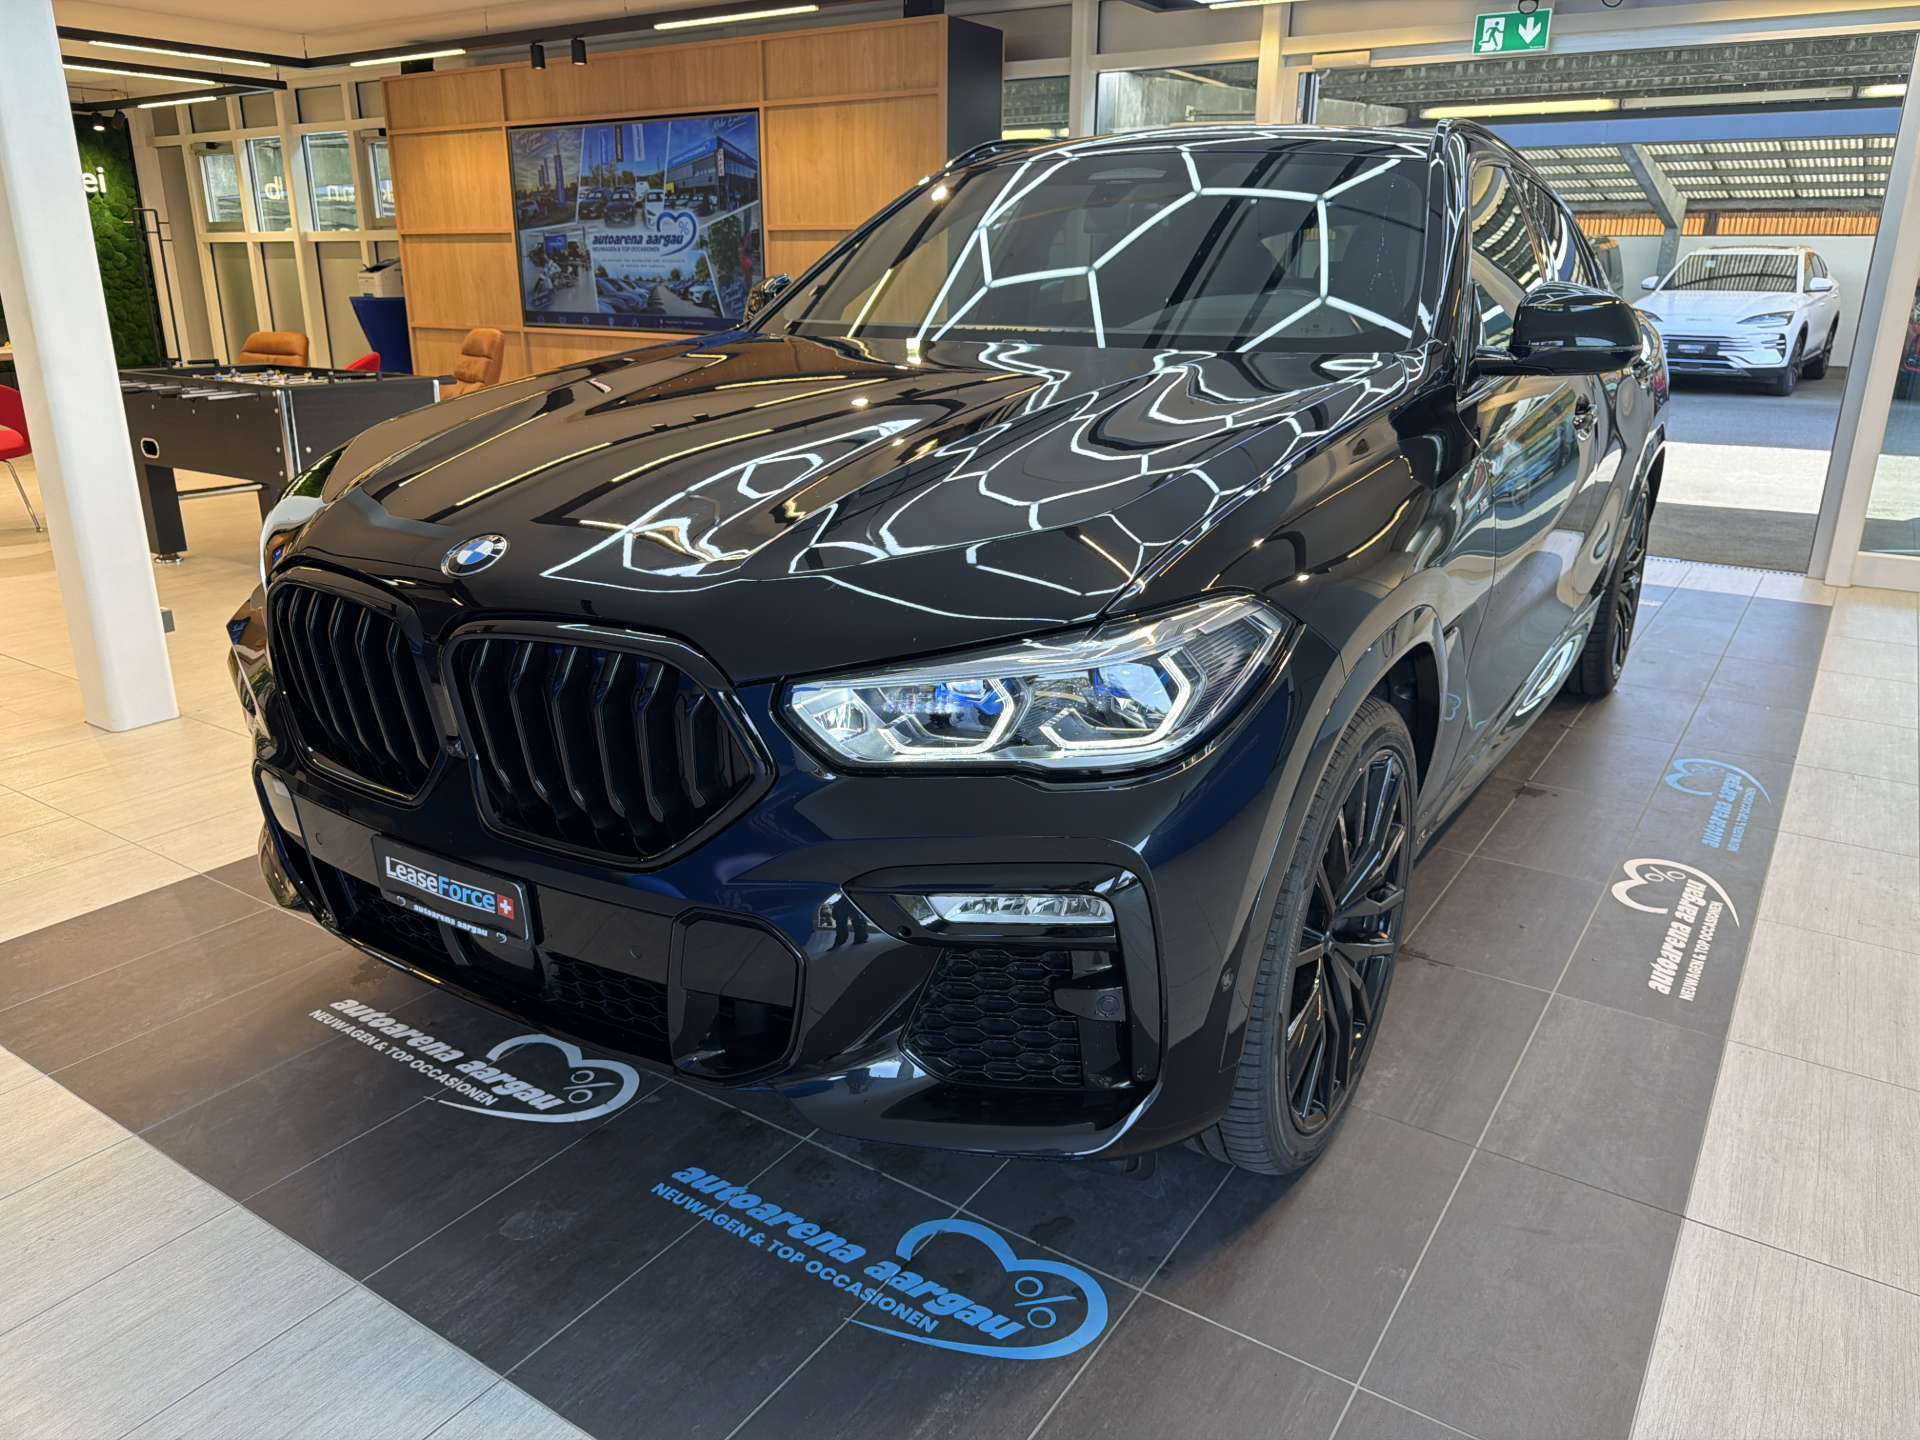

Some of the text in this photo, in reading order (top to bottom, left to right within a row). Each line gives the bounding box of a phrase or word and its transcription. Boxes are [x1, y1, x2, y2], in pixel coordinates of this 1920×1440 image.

[82, 166, 107, 193] ei
[592, 234, 684, 247] autoarena aargau
[385, 856, 496, 910] LeaseForce
[412, 903, 488, 937] autoarena aargau
[1648, 878, 1707, 995] autoarena aargau
[1679, 959, 1705, 1001] NEUWAGEN
[1694, 939, 1711, 954] TOP
[308, 1009, 499, 1106] NEUWAGEN & TOP OCCASIONEN
[329, 999, 566, 1110] autoarena aargau
[650, 1182, 939, 1333] NEUWAGEN & TOP OCCASIONEN
[671, 1166, 1026, 1340] autoarena aargau
